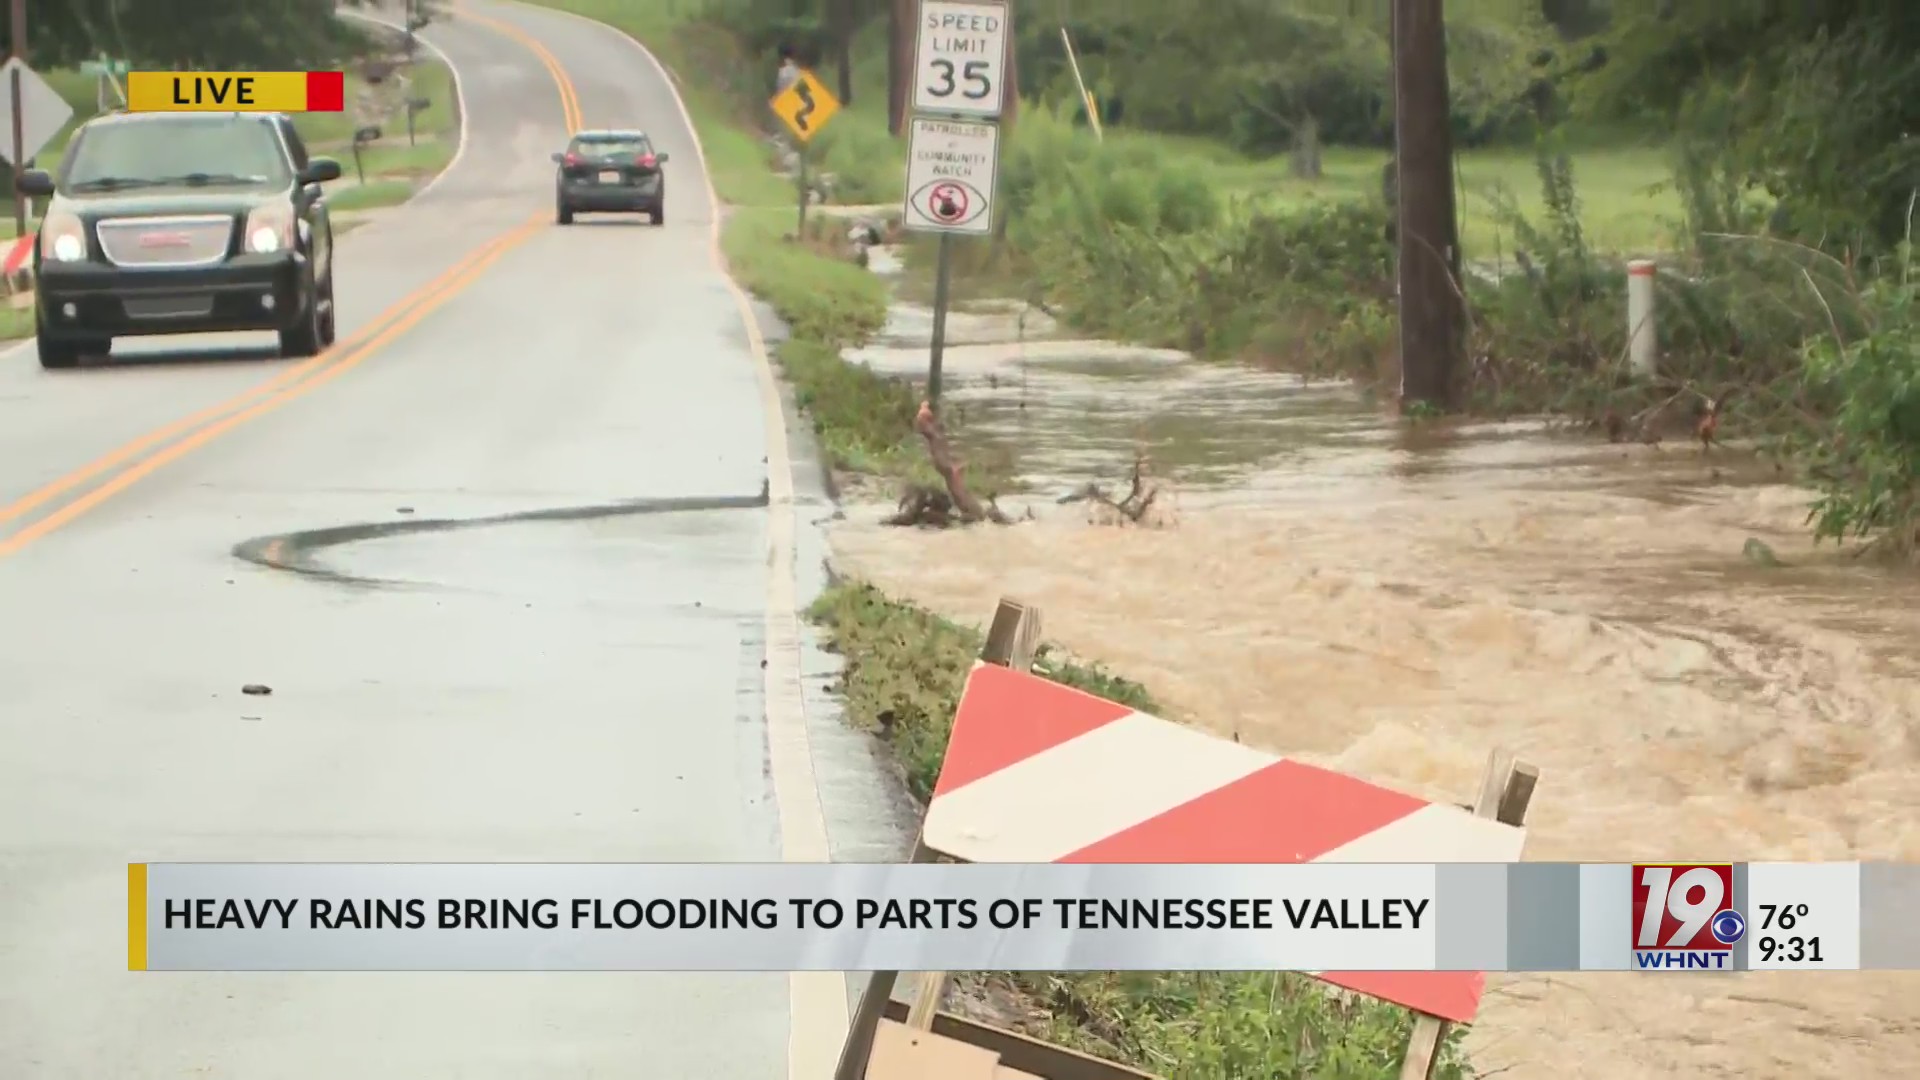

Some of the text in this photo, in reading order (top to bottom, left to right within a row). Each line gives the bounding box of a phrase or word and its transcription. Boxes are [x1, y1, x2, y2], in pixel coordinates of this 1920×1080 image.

[927, 13, 998, 33] SPEED
[932, 36, 987, 53] LIMIT
[926, 58, 992, 99] 35
[917, 150, 986, 166] COMMUNITY
[932, 164, 972, 177] WATCH
